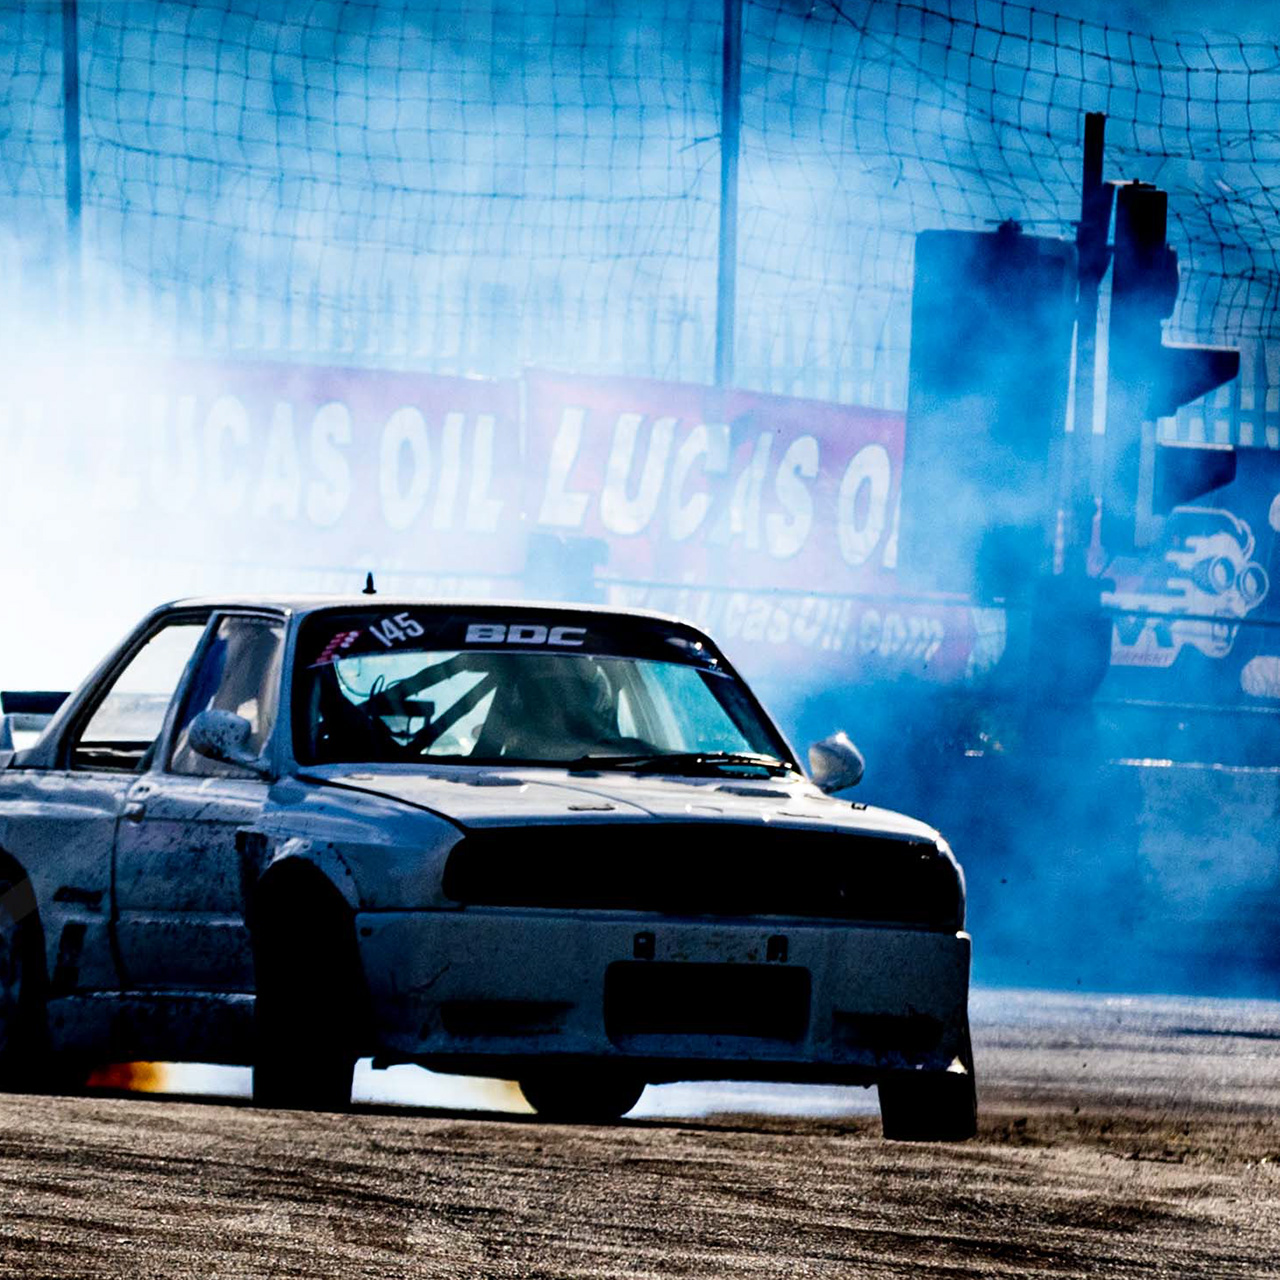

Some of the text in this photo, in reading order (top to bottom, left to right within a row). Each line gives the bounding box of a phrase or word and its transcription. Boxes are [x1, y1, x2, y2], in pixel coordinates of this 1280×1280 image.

[378, 405, 505, 532] OIL
[540, 406, 820, 559] LUCAS
[369, 611, 426, 648] 145
[464, 623, 588, 647] BDC
